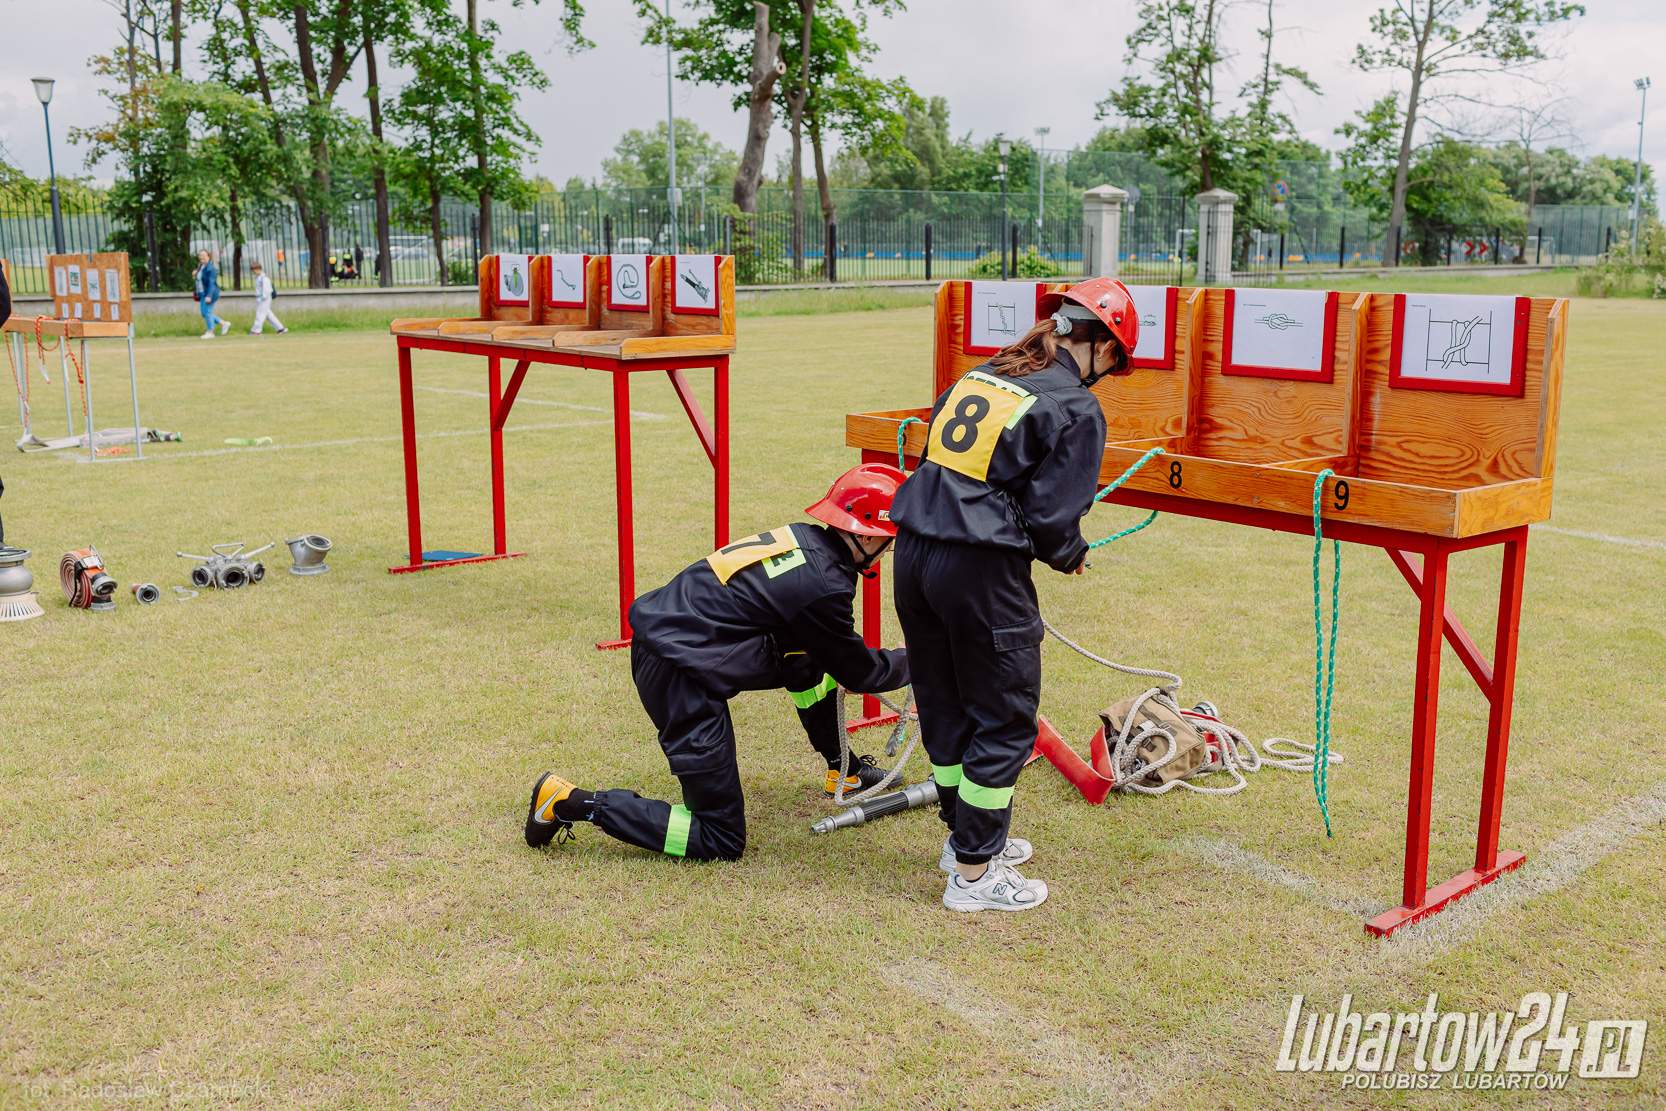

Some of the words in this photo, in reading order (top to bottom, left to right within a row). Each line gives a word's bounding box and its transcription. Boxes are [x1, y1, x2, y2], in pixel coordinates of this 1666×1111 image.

[941, 394, 991, 453] 8
[1169, 461, 1183, 489] 8
[1334, 480, 1350, 511] 9
[721, 531, 777, 555] 7
